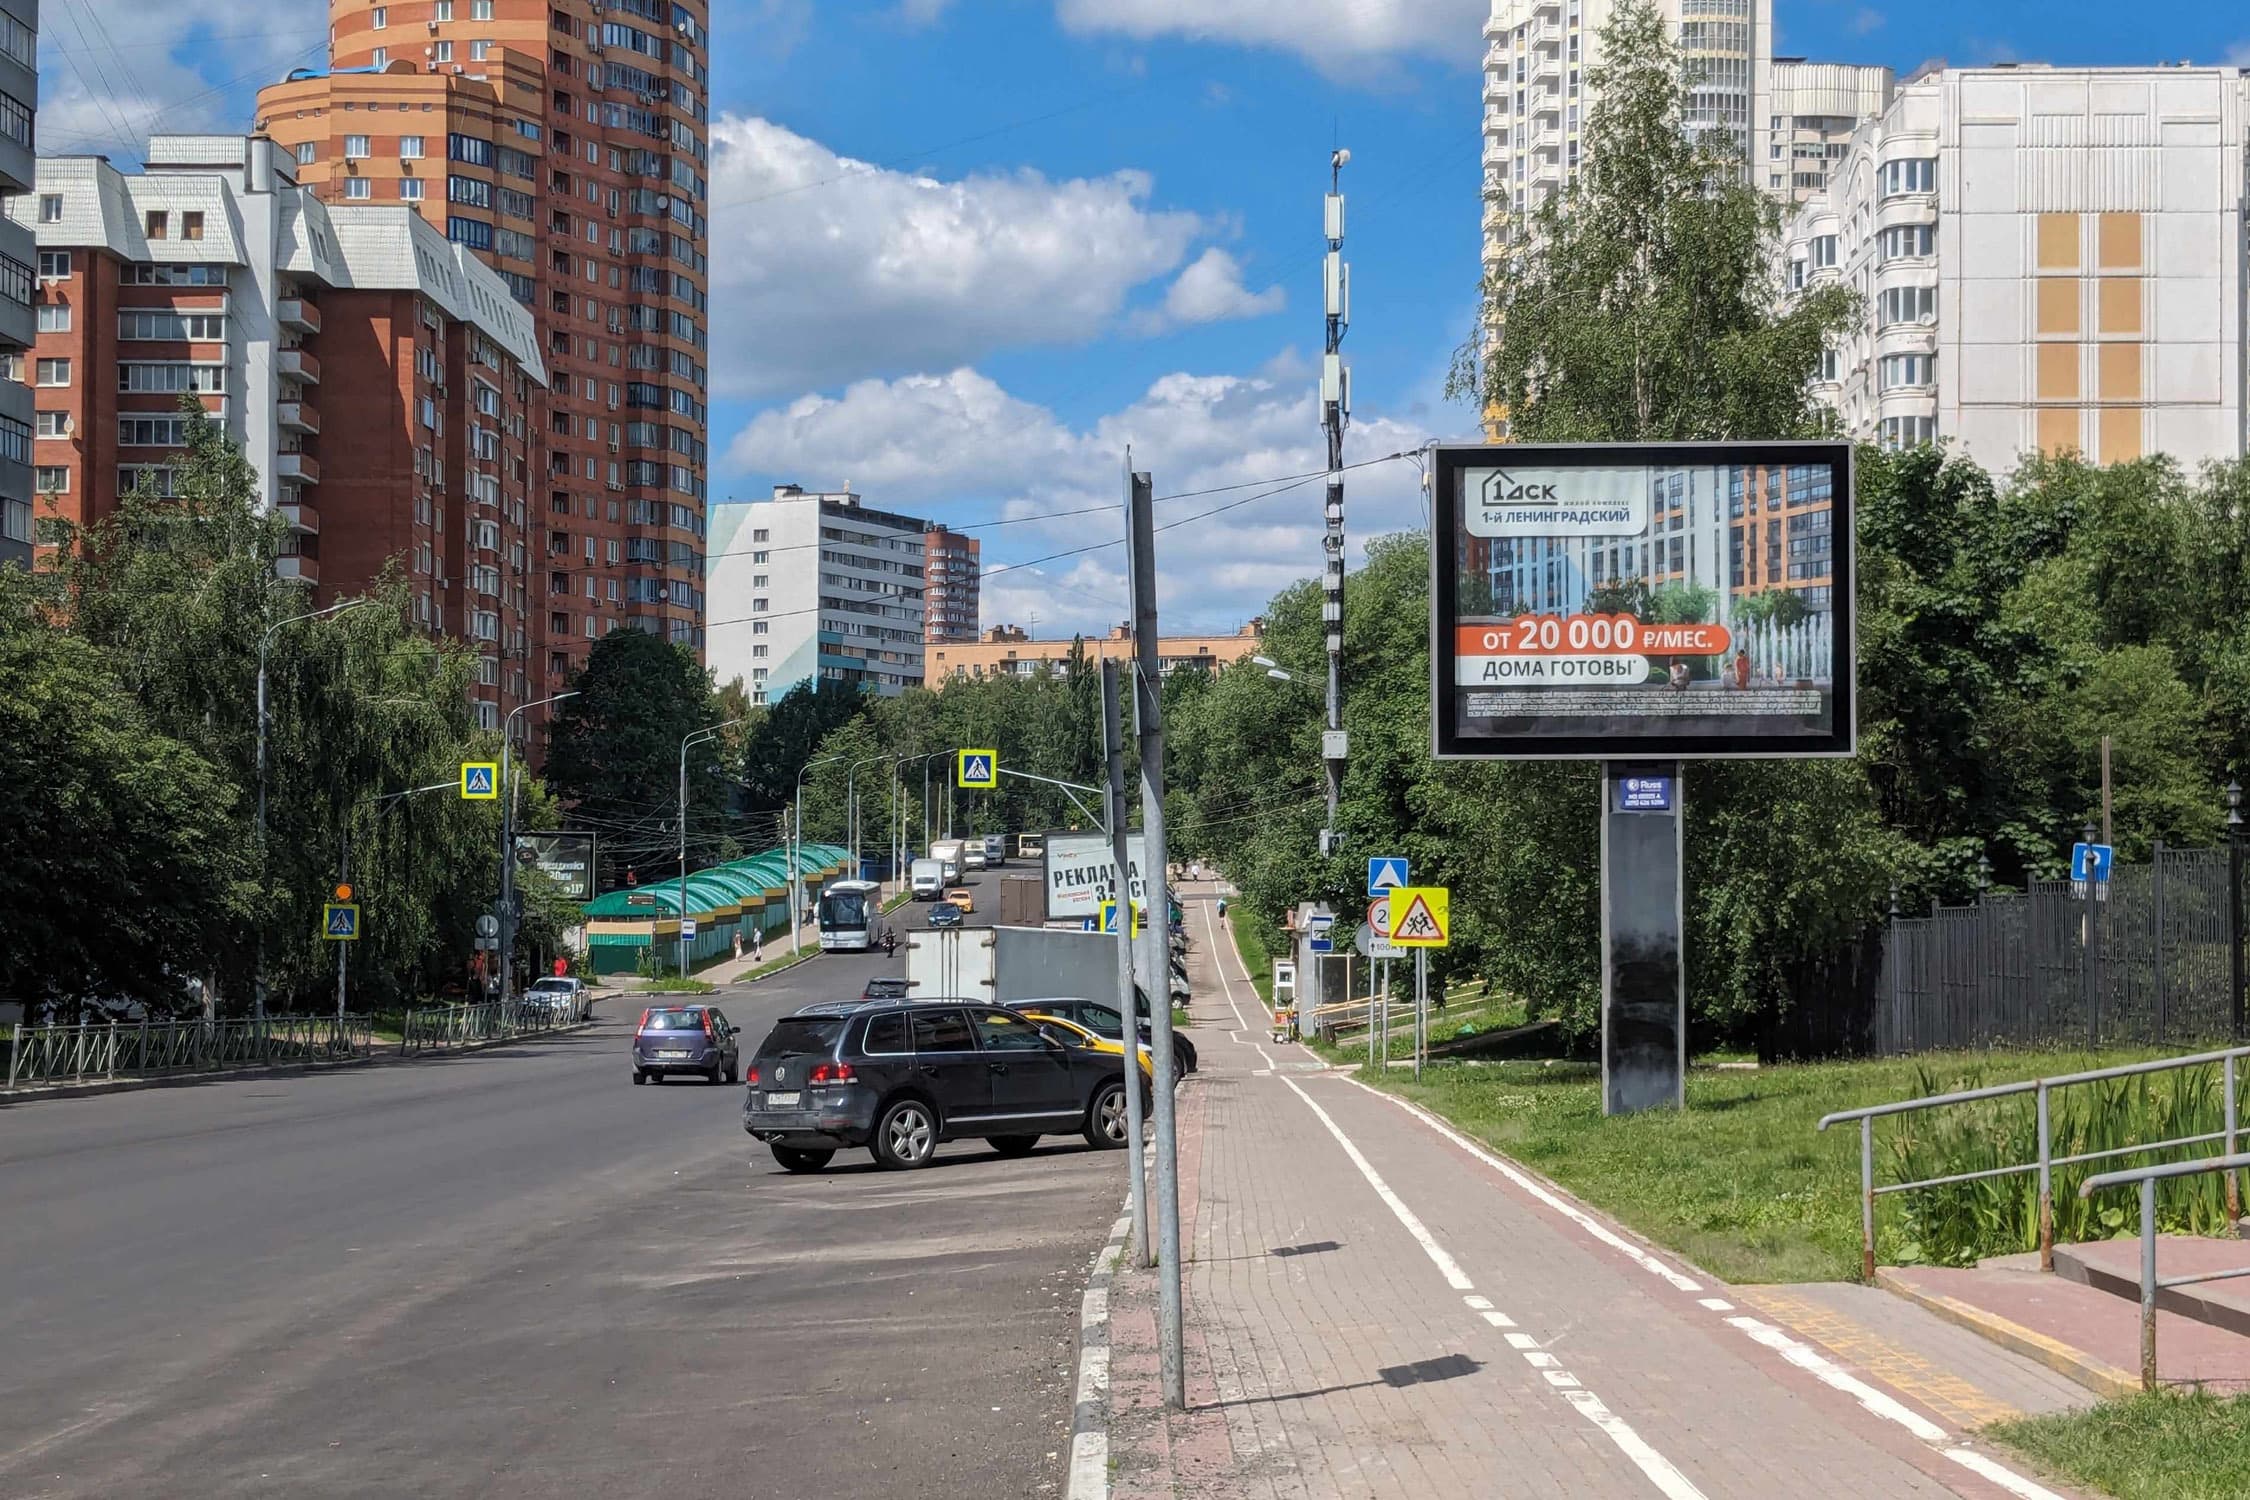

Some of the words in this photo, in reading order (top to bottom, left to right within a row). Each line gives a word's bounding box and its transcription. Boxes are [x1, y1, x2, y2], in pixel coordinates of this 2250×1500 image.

[1505, 507, 1630, 526] ЛЕНИНГРАДСКИЙ
[1483, 632, 1512, 650] ОТ
[1518, 619, 1561, 650] 20
[1568, 619, 1635, 649] 000
[1483, 661, 1545, 681] ДОМА
